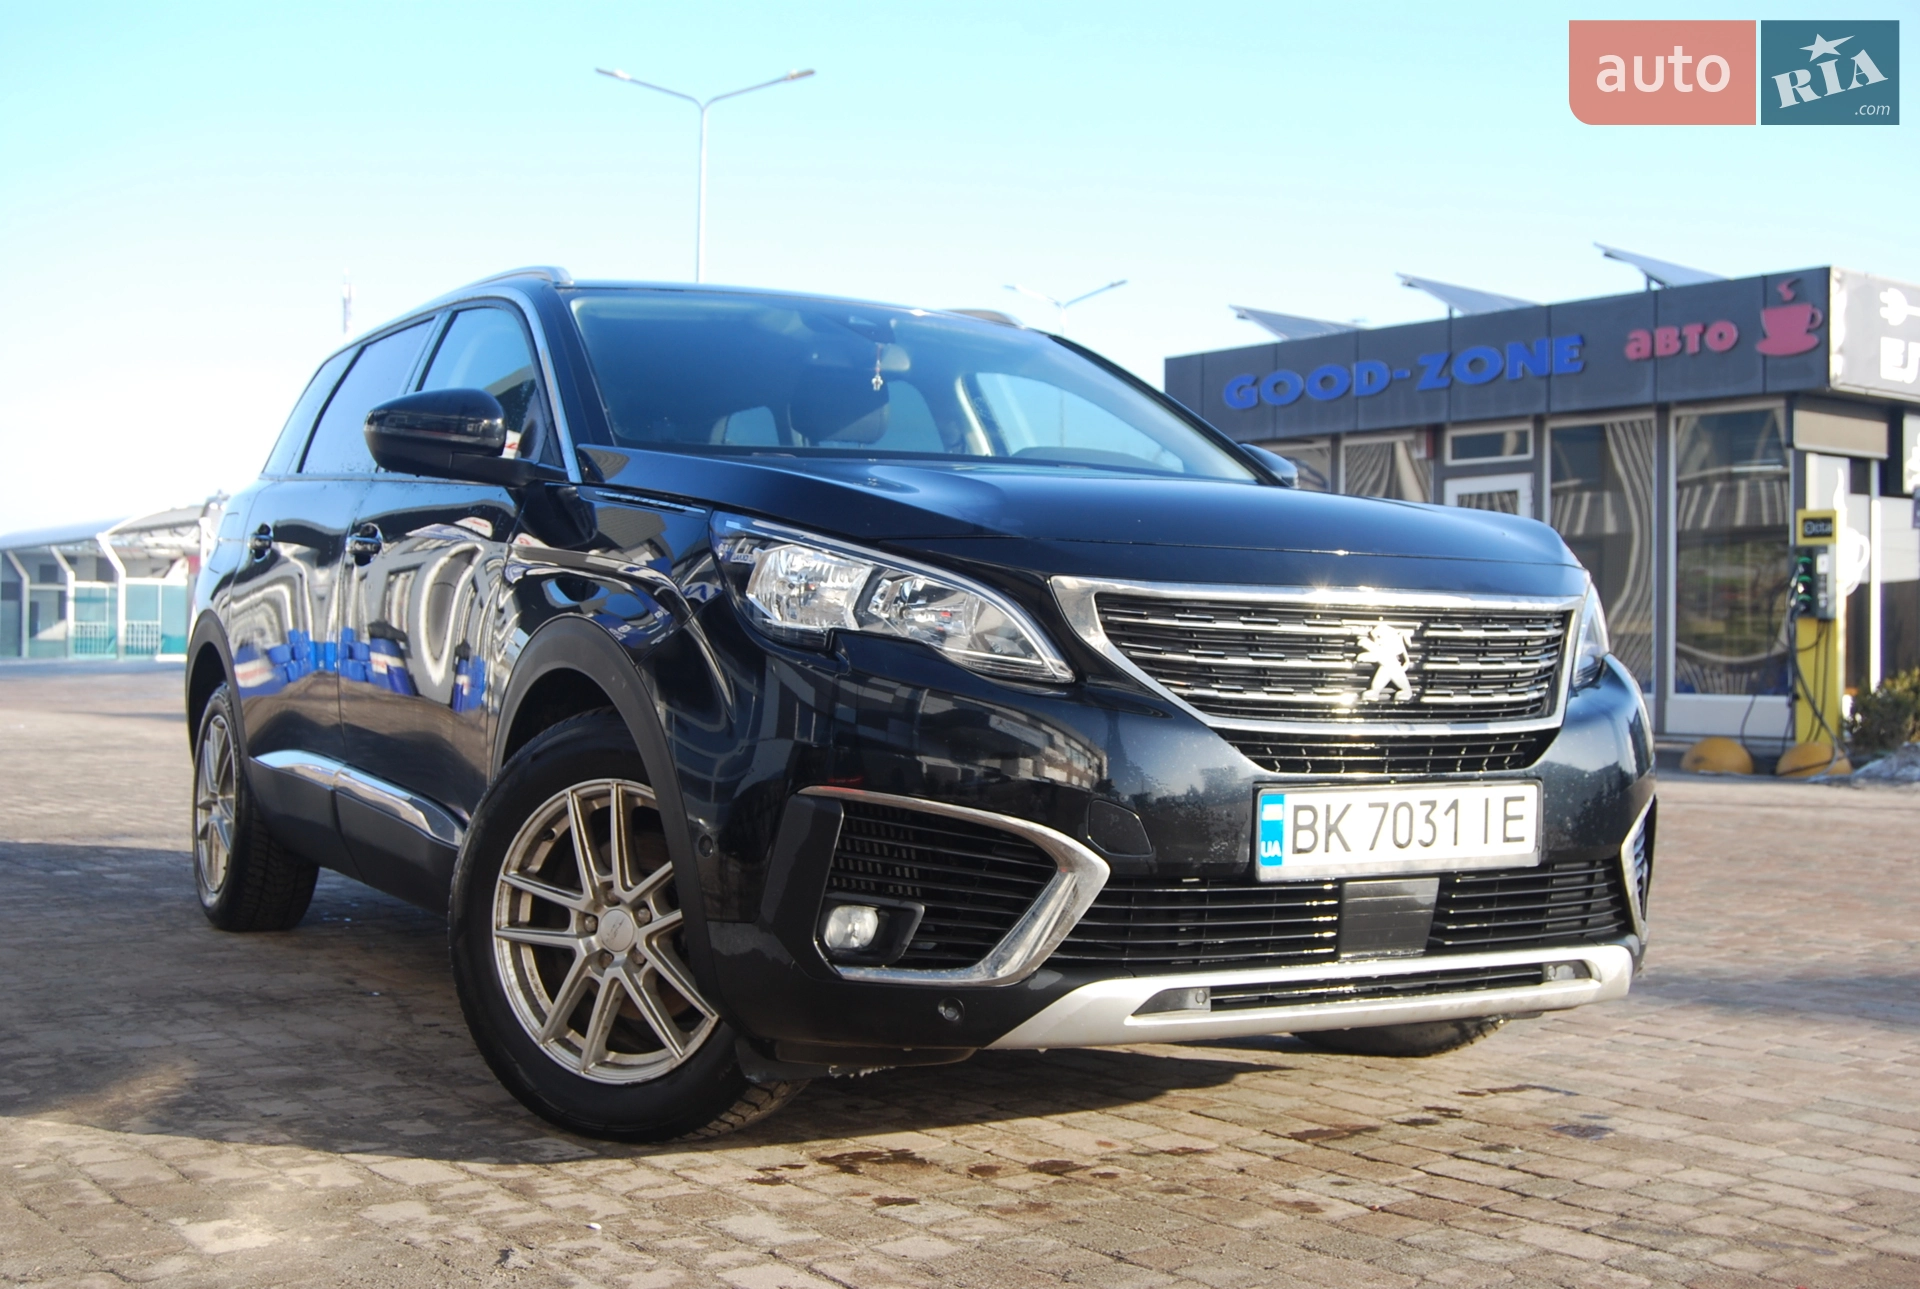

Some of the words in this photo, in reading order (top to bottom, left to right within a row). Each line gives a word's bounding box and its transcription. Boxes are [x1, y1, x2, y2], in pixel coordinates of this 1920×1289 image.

[1223, 334, 1585, 410] GOOD-ZONE
[1260, 840, 1282, 858] UA
[1291, 803, 1352, 855] BK
[1368, 798, 1460, 851] 7031
[1484, 796, 1526, 845] IE
